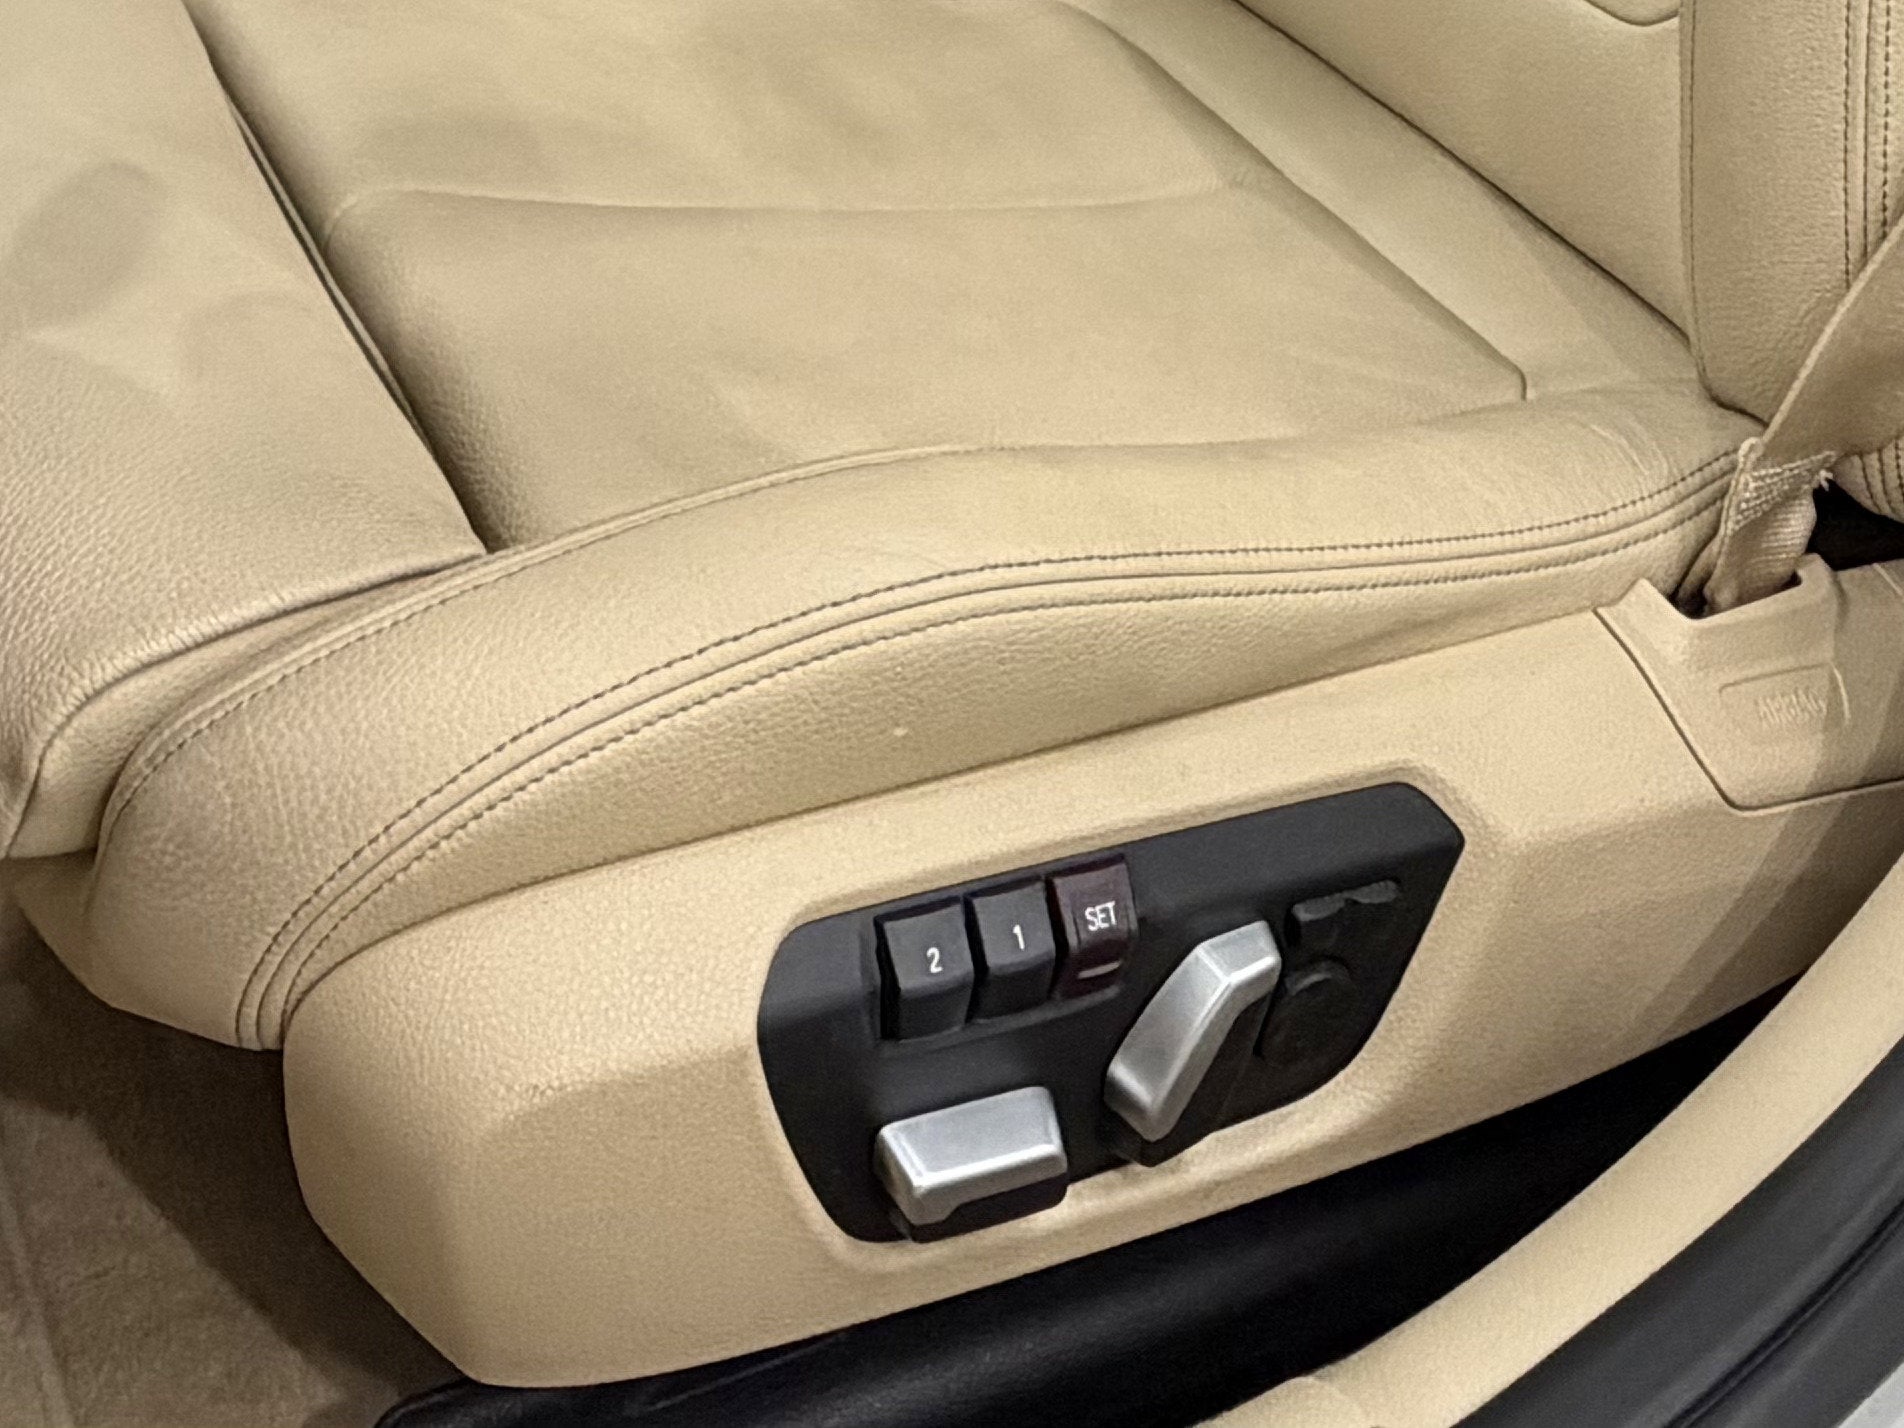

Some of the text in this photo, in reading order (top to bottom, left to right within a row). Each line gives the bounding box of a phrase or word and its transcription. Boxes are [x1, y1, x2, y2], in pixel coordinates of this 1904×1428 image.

[925, 901, 1119, 974] 2 1 SET
